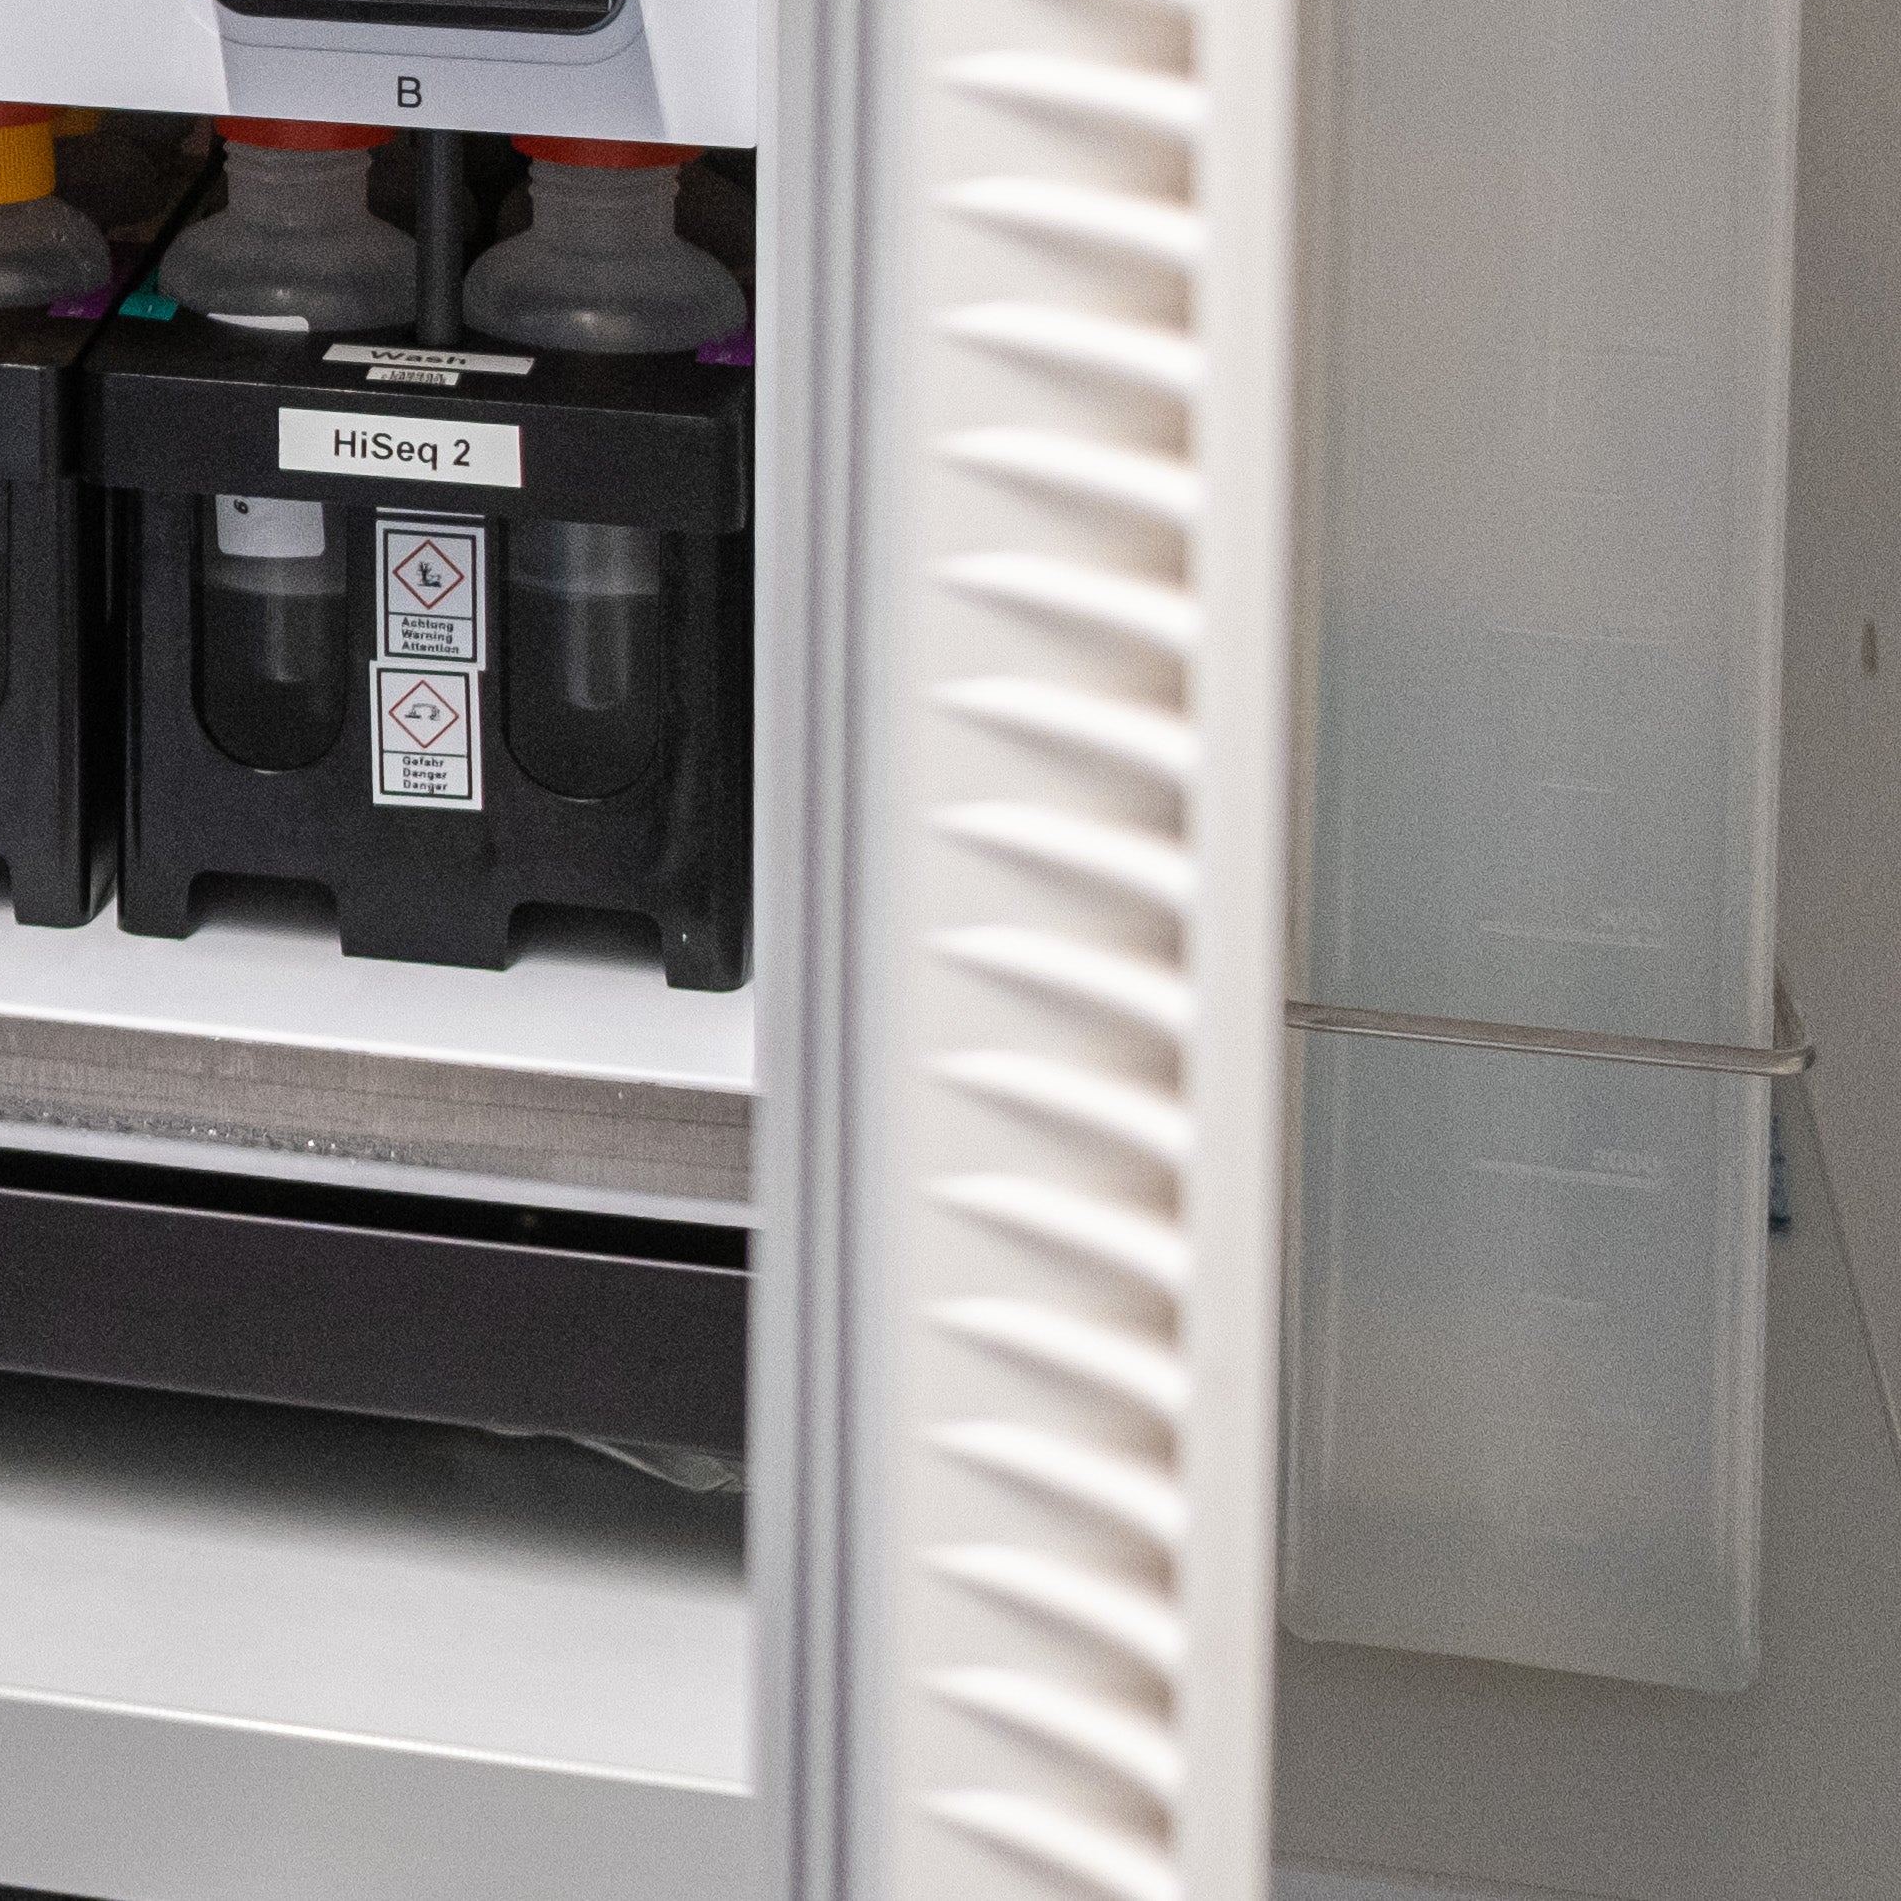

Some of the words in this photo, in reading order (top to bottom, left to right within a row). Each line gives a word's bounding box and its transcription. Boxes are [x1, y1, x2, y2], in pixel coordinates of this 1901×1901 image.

[397, 76, 422, 108] B
[370, 350, 466, 366] Wash
[334, 429, 437, 471] HiSeq
[453, 439, 471, 467] 2
[402, 617, 454, 633] Achtung
[401, 629, 453, 644] Warning
[402, 640, 459, 655] Attention
[402, 756, 444, 768] Gefahr
[403, 767, 447, 780] Danger
[403, 779, 448, 794] Danger
